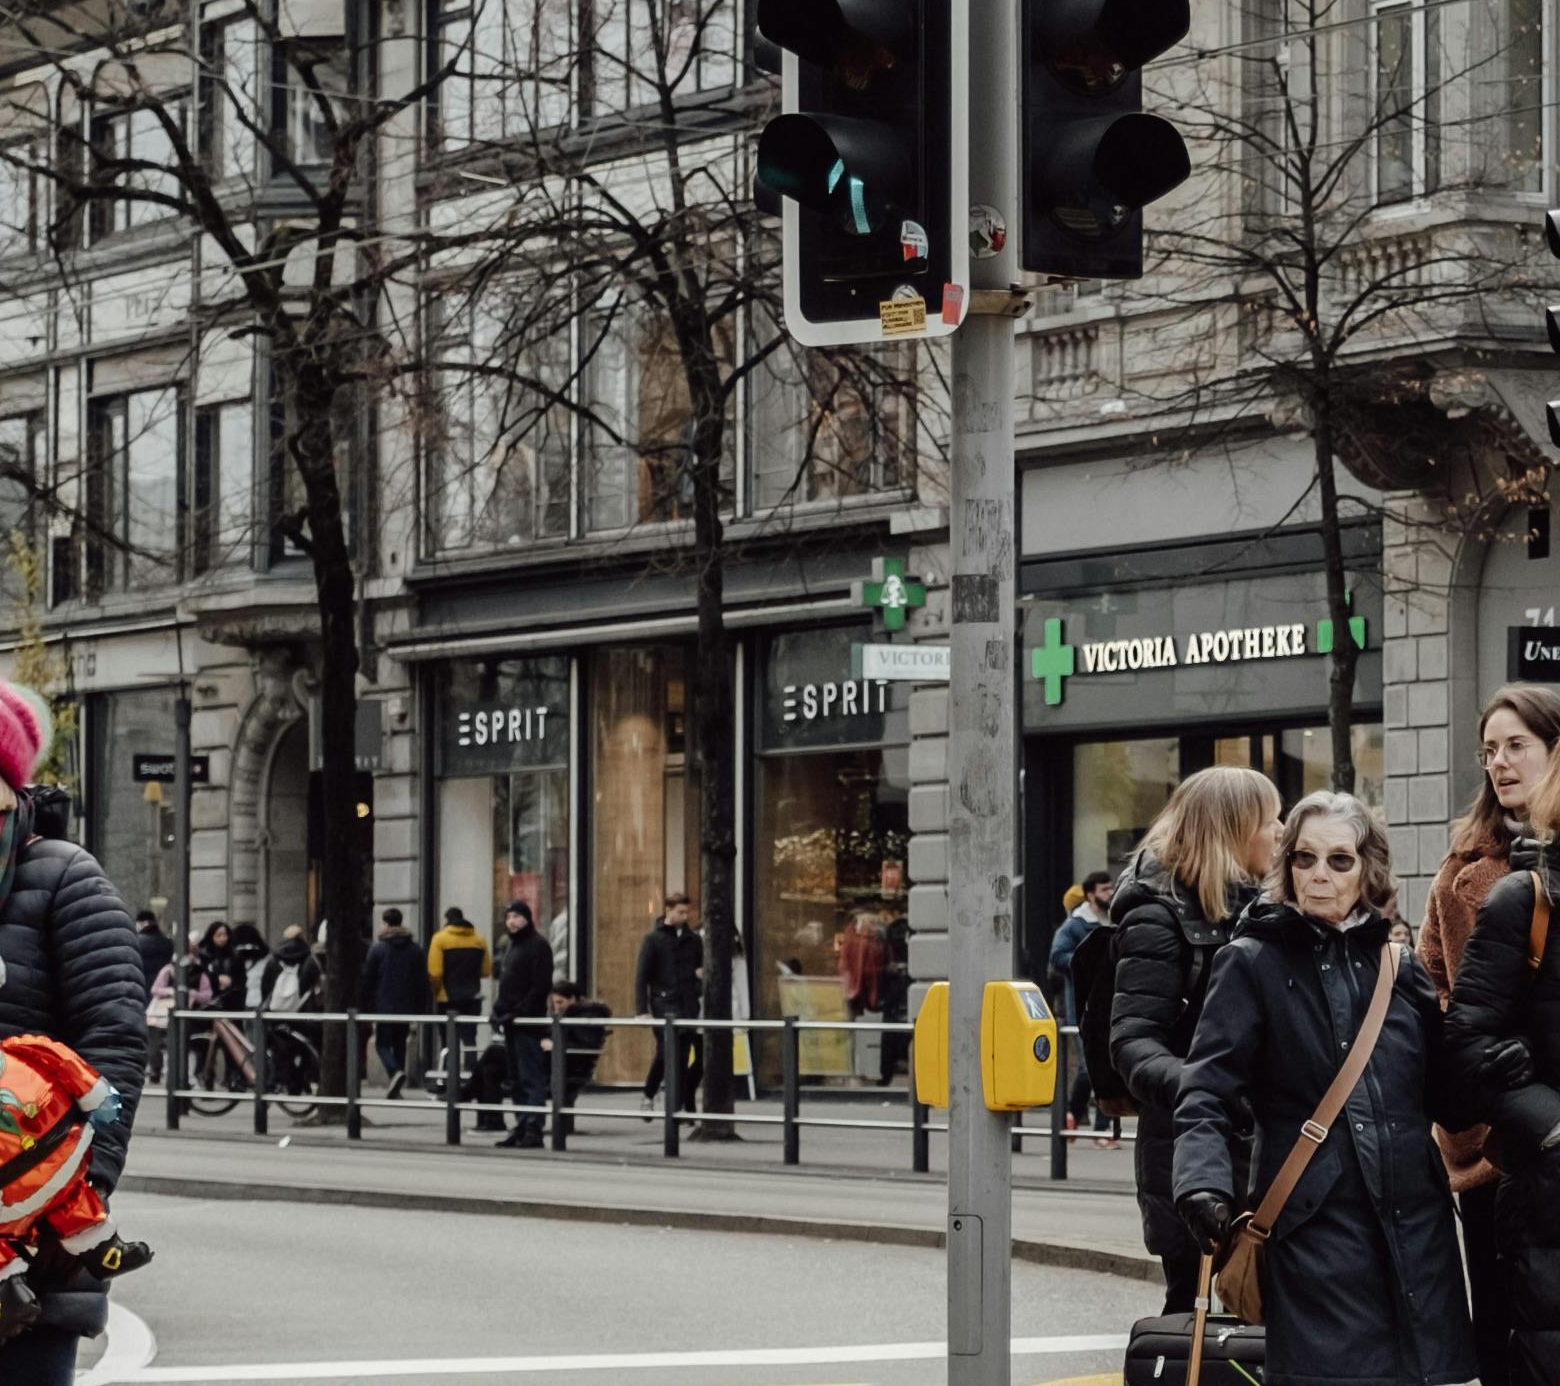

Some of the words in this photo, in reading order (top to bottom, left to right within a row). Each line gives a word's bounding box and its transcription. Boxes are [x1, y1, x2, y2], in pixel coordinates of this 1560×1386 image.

[1082, 635, 1178, 673] VICTORIA
[1185, 623, 1306, 664] APOTHEKE
[783, 680, 888, 721] ESPRIT
[458, 706, 548, 745] ESPRIT
